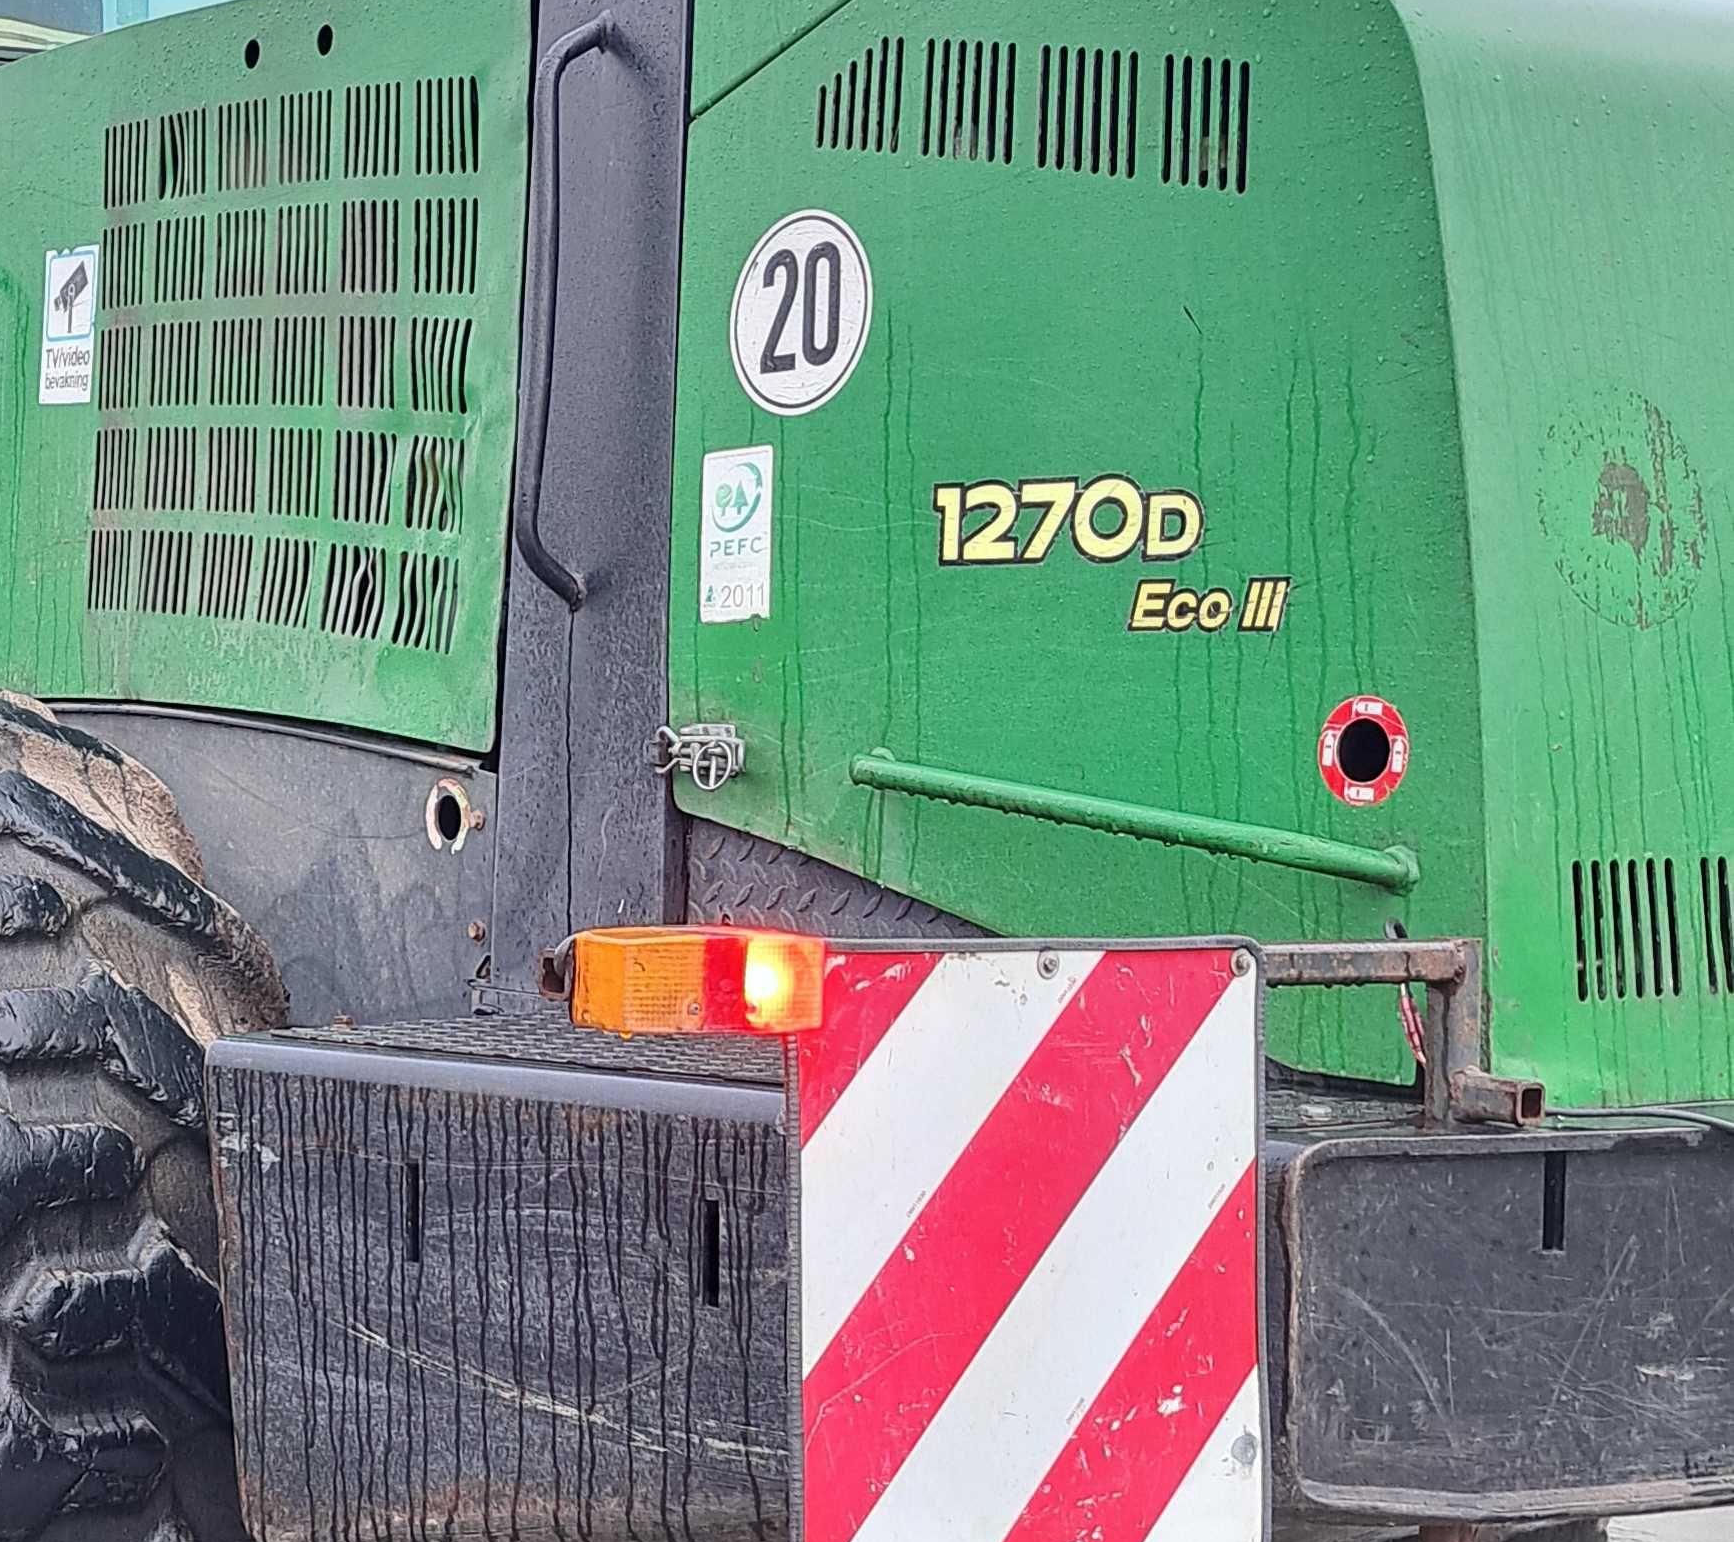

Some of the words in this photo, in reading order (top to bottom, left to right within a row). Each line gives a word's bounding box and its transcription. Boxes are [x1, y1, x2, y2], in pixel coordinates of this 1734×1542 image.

[760, 241, 841, 374] 20
[46, 346, 91, 369] TV/video
[933, 474, 1203, 564] 1270D
[710, 536, 764, 558] PEFC
[720, 581, 765, 609] 2011
[1128, 579, 1233, 632] Eco
[1238, 577, 1289, 632] III
